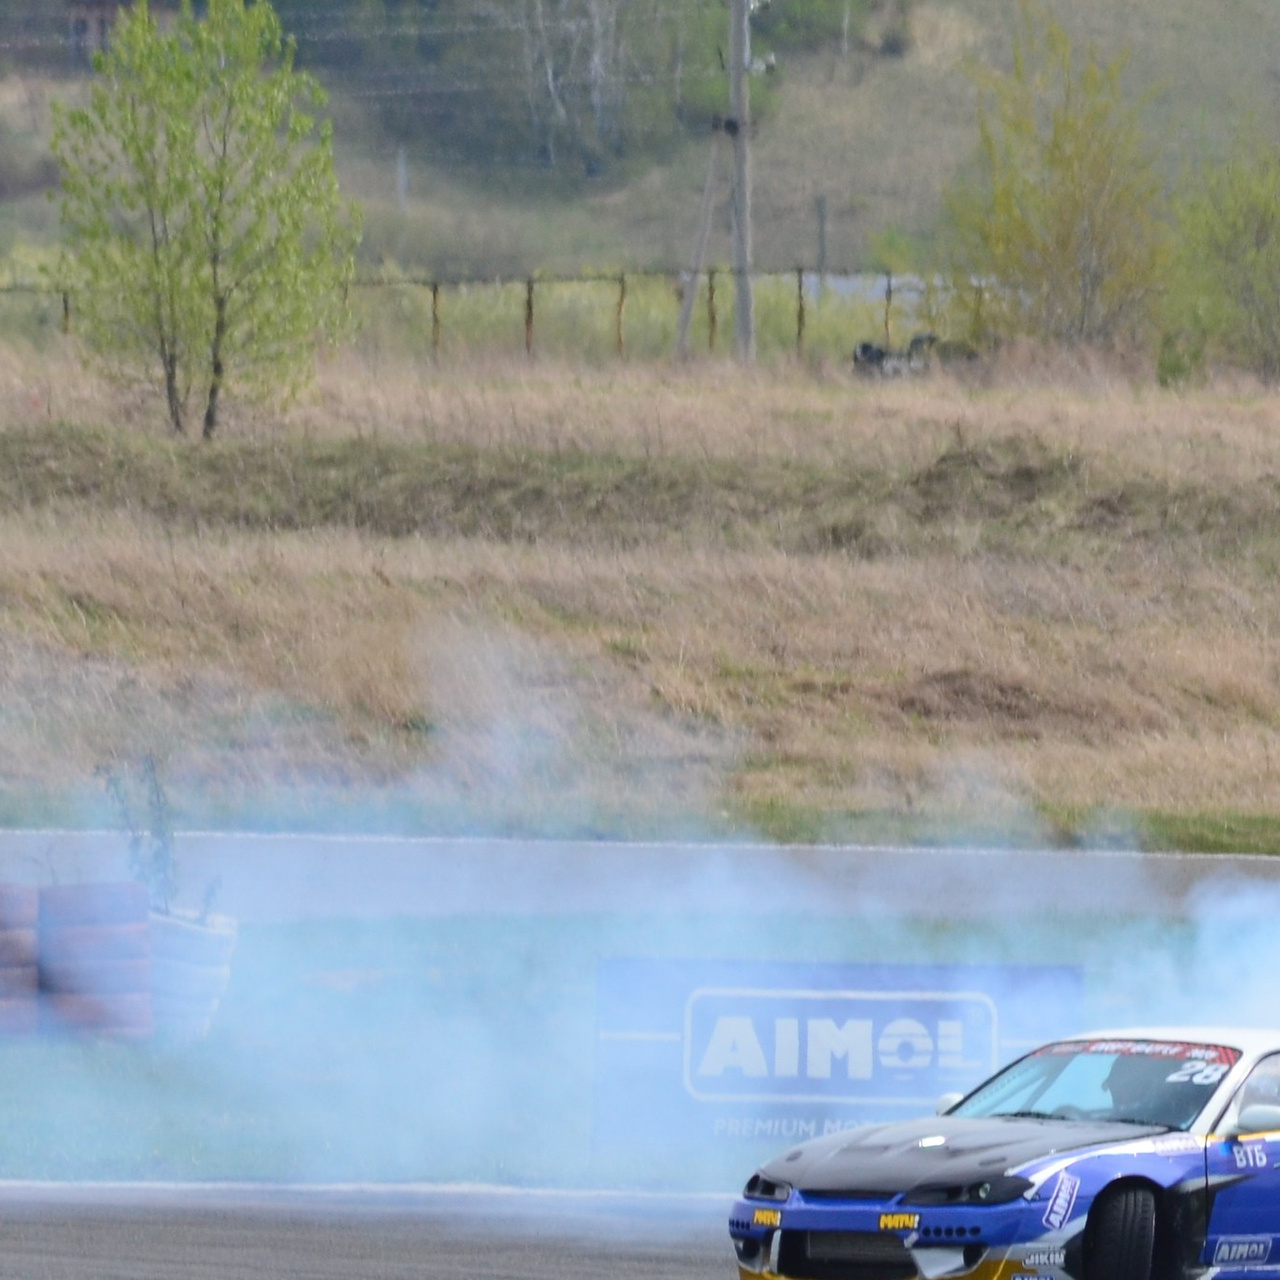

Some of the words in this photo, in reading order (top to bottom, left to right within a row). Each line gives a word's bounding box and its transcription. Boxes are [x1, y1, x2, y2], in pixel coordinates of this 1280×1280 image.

[698, 1016, 984, 1080] AIMOL
[1165, 1061, 1229, 1085] 28
[714, 1118, 816, 1137] PREMIUM
[1232, 1144, 1267, 1169] ВТБ
[1217, 1243, 1264, 1261] AIMOL
